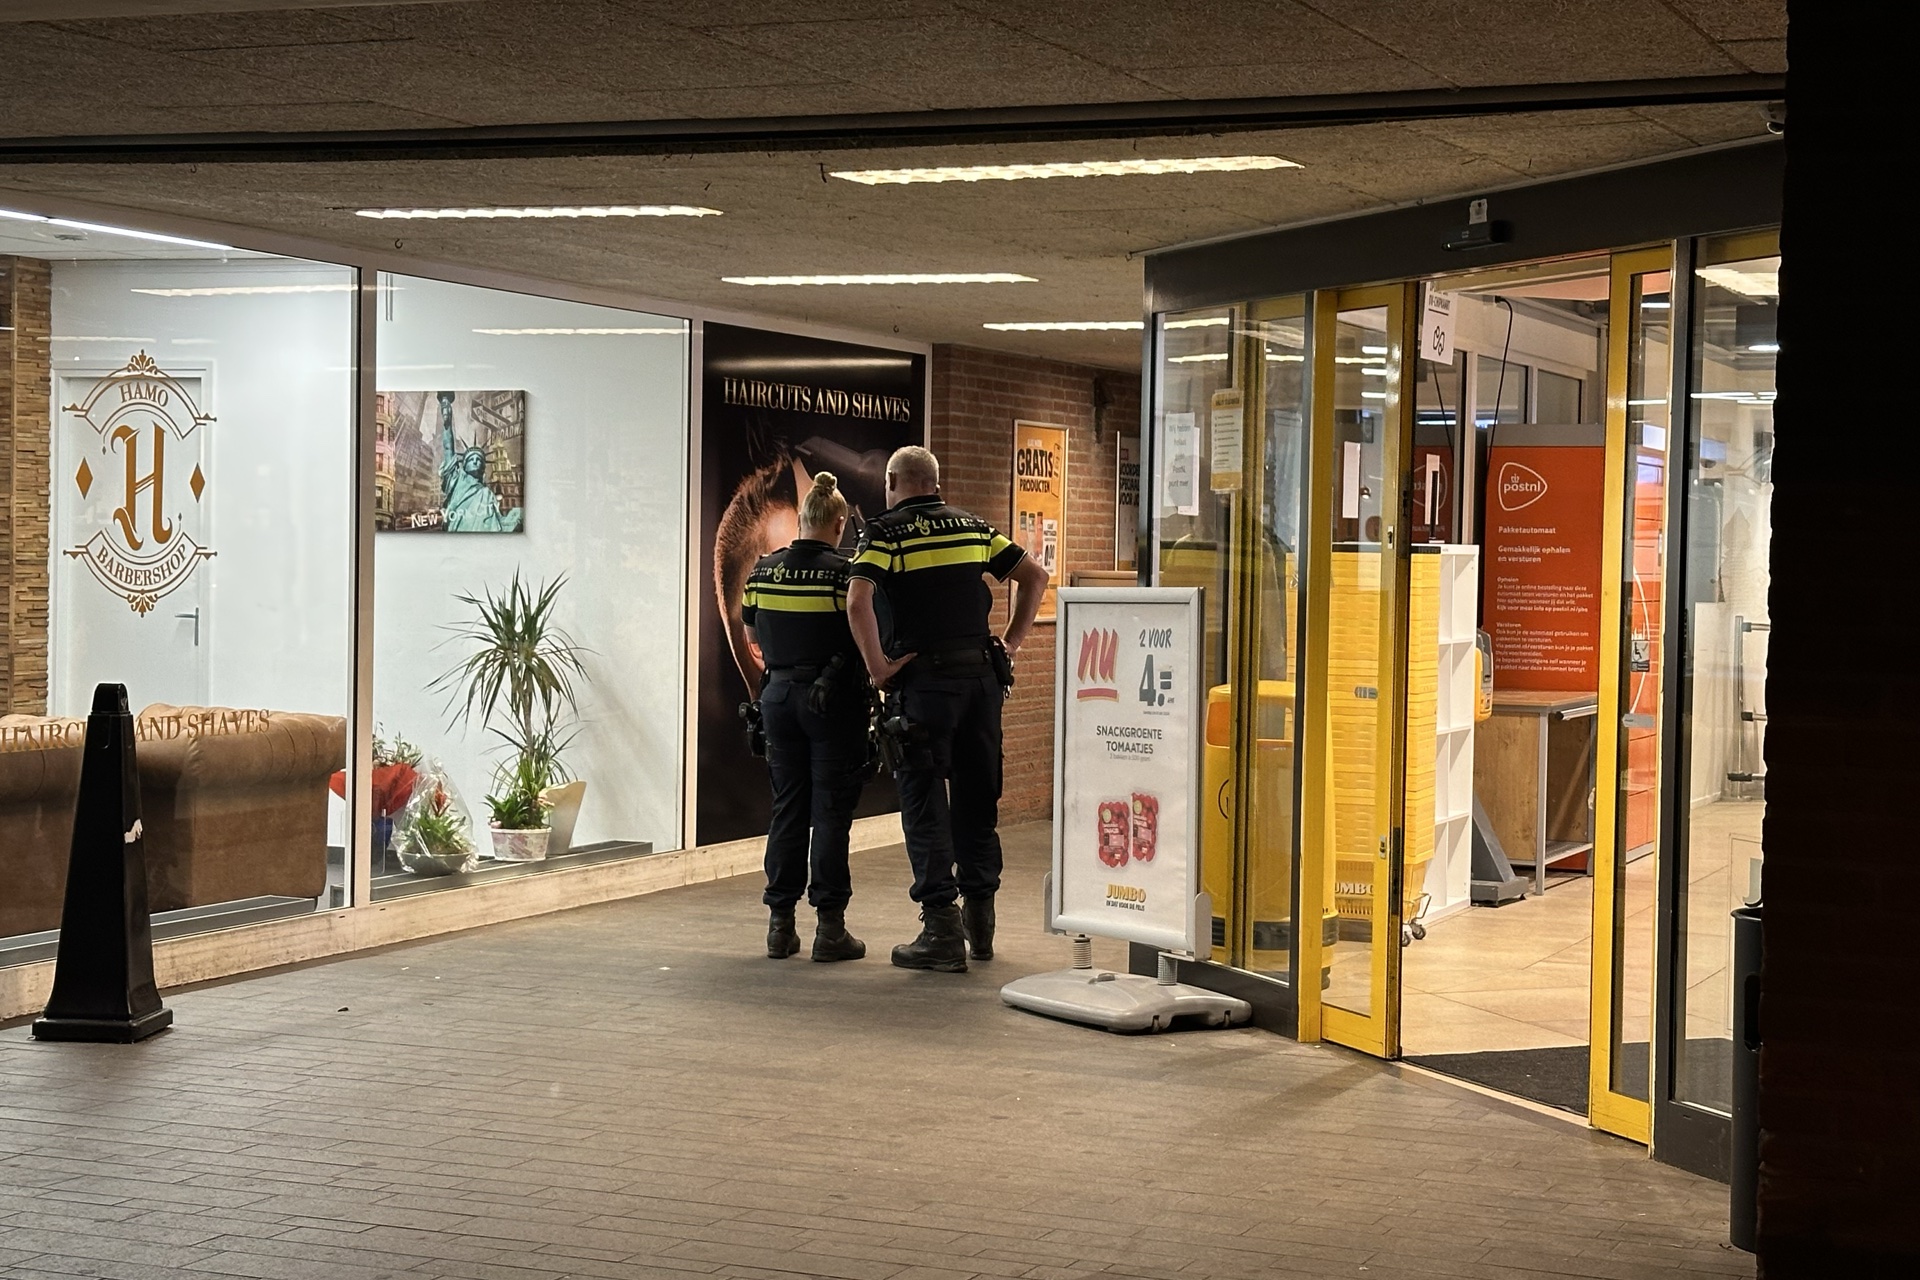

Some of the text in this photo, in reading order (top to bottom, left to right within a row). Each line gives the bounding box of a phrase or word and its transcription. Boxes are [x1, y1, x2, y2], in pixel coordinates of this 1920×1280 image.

[119, 381, 169, 407] HAMO
[724, 377, 911, 423] HAIRCUTS AND SHAVES
[1017, 448, 1054, 478] GRATIS
[111, 420, 173, 551] H
[1020, 479, 1050, 493] PRODUCTEN
[1504, 481, 1541, 494] postnl
[411, 511, 438, 528] NEW
[907, 516, 968, 535] POLITIE
[1498, 526, 1556, 534] Pakketautomaat
[1498, 545, 1571, 555] Gemakkelijk ophalen
[96, 544, 187, 586] BARBERSHOP
[766, 566, 824, 582] POLITIE
[1139, 628, 1172, 648] 2 VOOR
[136, 715, 182, 742] AND
[187, 709, 270, 737] SHAVES
[1096, 725, 1163, 740] SNACKGROENTE
[1106, 741, 1154, 754] TOMAATJES
[1106, 883, 1146, 903] JUMBO
